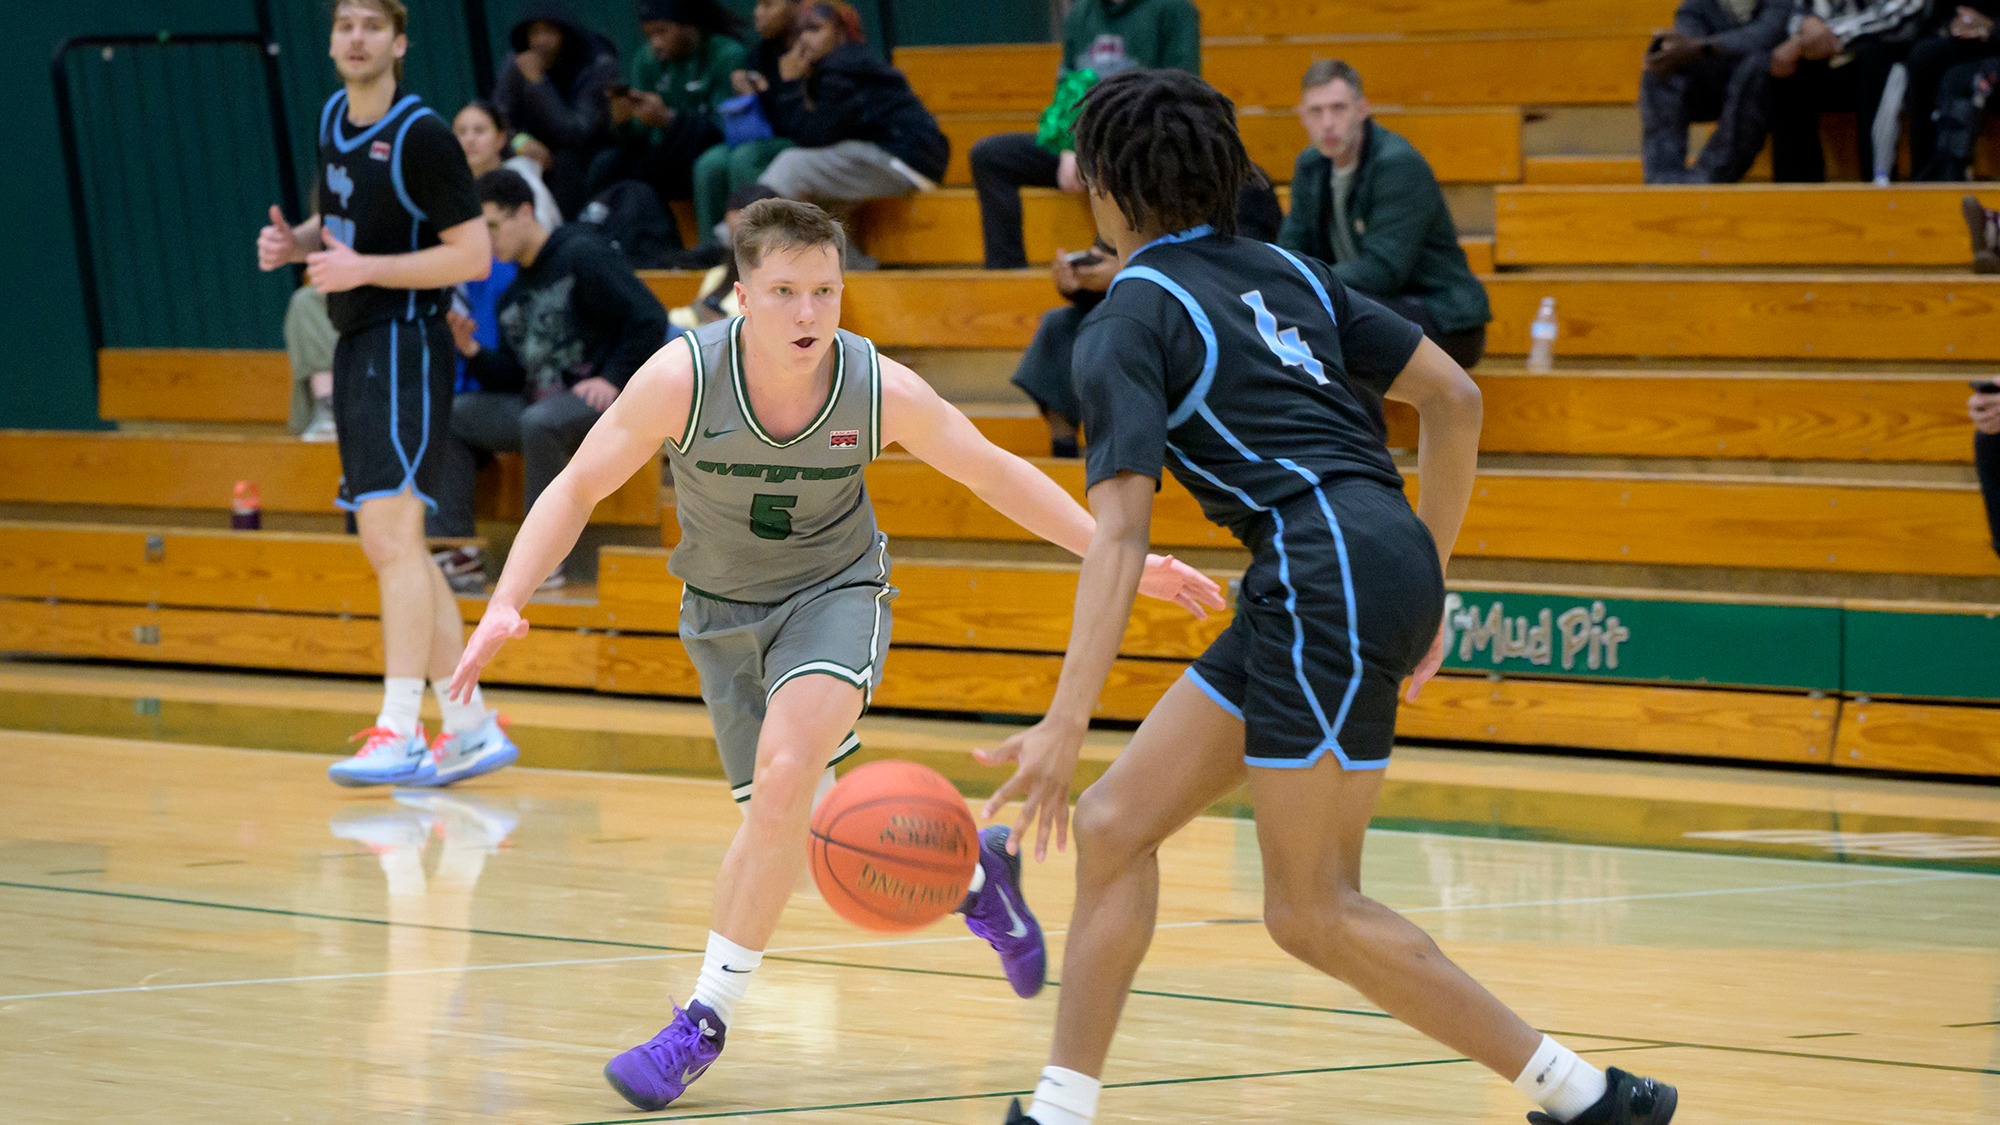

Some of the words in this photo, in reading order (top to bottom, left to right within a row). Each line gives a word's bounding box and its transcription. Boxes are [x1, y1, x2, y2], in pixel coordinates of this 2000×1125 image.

[1240, 289, 1331, 386] 4
[695, 460, 862, 483] evergreen
[749, 493, 798, 540] 5
[1458, 601, 1553, 666] Mud
[1556, 600, 1631, 670] Pit
